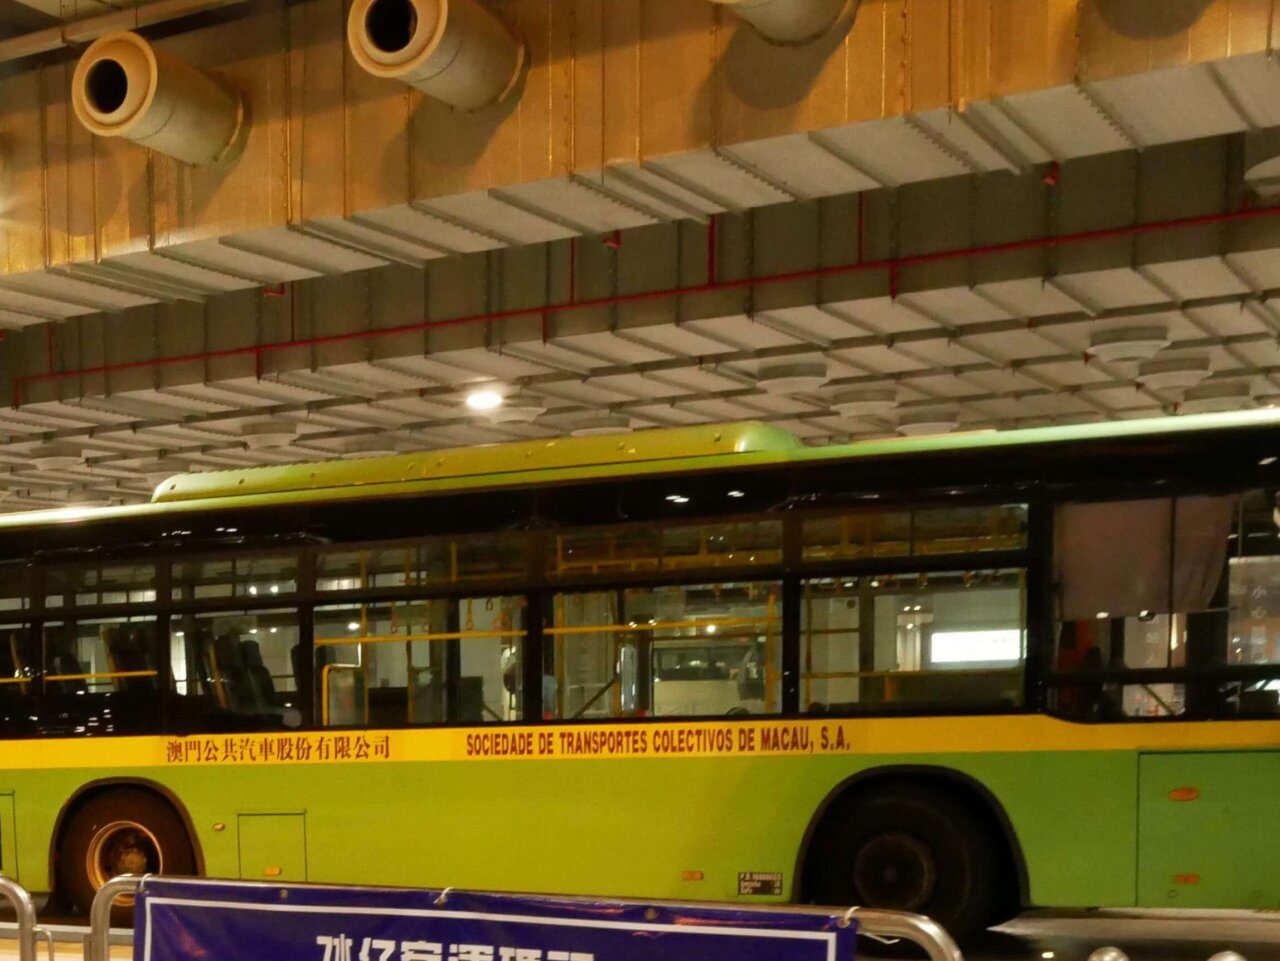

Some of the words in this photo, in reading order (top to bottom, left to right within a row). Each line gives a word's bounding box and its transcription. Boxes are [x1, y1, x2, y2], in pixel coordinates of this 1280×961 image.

[166, 735, 390, 762] 澳門公共汽車股份有限公司
[466, 732, 533, 756] SOCIEDADE
[538, 731, 554, 754] DE
[560, 731, 647, 753] TRANSPORTES
[654, 729, 732, 752] COLECTIVOS
[739, 728, 754, 751] DE
[761, 727, 813, 753] MACAU,
[821, 725, 850, 750] S.A.
